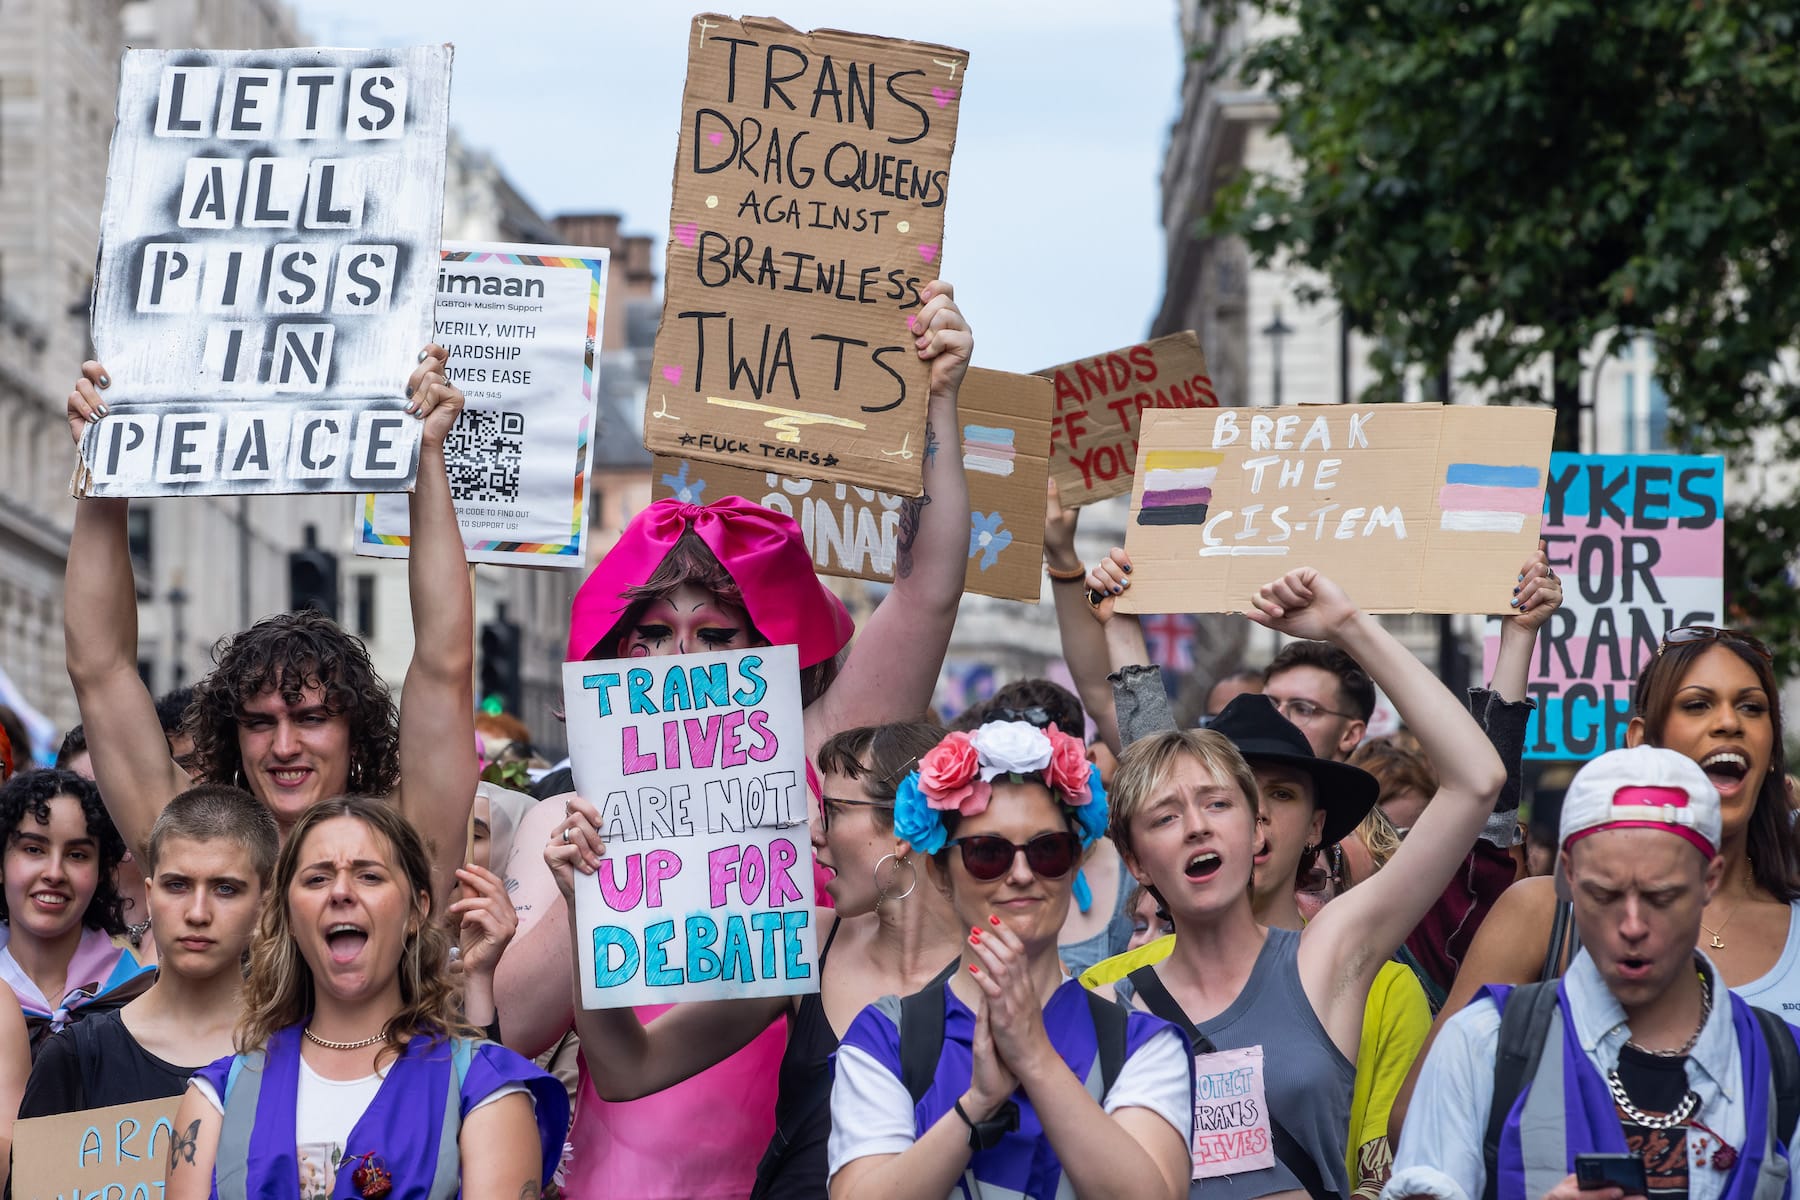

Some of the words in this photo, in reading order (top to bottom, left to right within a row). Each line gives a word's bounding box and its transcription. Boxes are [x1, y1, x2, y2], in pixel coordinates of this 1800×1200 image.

[167, 73, 395, 131] LETS
[709, 36, 931, 145] TRANS
[694, 109, 815, 189] DRAG
[824, 141, 948, 208] QUEENS
[189, 164, 352, 223] ALL
[738, 190, 890, 234] AGAINST
[150, 250, 385, 306] PISS
[438, 268, 544, 298] imaan
[697, 231, 924, 309] BRAINLESS
[435, 321, 491, 338] VERILY,
[497, 324, 536, 338] WITH
[437, 300, 472, 309] LGBTQI+
[474, 302, 505, 310] Muslim
[508, 303, 543, 312] Support
[222, 330, 324, 384] IN
[444, 367, 486, 382] OMES
[492, 369, 531, 384] EASE
[678, 311, 907, 413] TWATS
[1054, 346, 1158, 411] ANDS
[460, 390, 484, 398] UR'AN
[106, 419, 403, 475] PEACE
[700, 434, 750, 453] FUCK
[759, 443, 820, 466] TERFS
[1050, 411, 1089, 456] FF
[1212, 411, 1375, 451] BREAK
[1070, 439, 1138, 490] YOU
[1242, 455, 1342, 494] THE
[461, 520, 470, 528] TO
[471, 521, 504, 529] SUPPORT
[465, 508, 485, 516] CODE
[487, 509, 496, 517] TO
[1202, 503, 1408, 546] CIS-TEM
[1546, 464, 1717, 531] YKES
[1487, 607, 1715, 681] RAN
[583, 655, 768, 718] TRANS
[622, 710, 779, 776] LIVES
[600, 784, 693, 843] ARE
[704, 771, 796, 834] NOT
[598, 849, 682, 912] UP
[708, 838, 803, 909] FOR
[592, 911, 811, 989] DEBATE
[1196, 1067, 1254, 1100] OTECT
